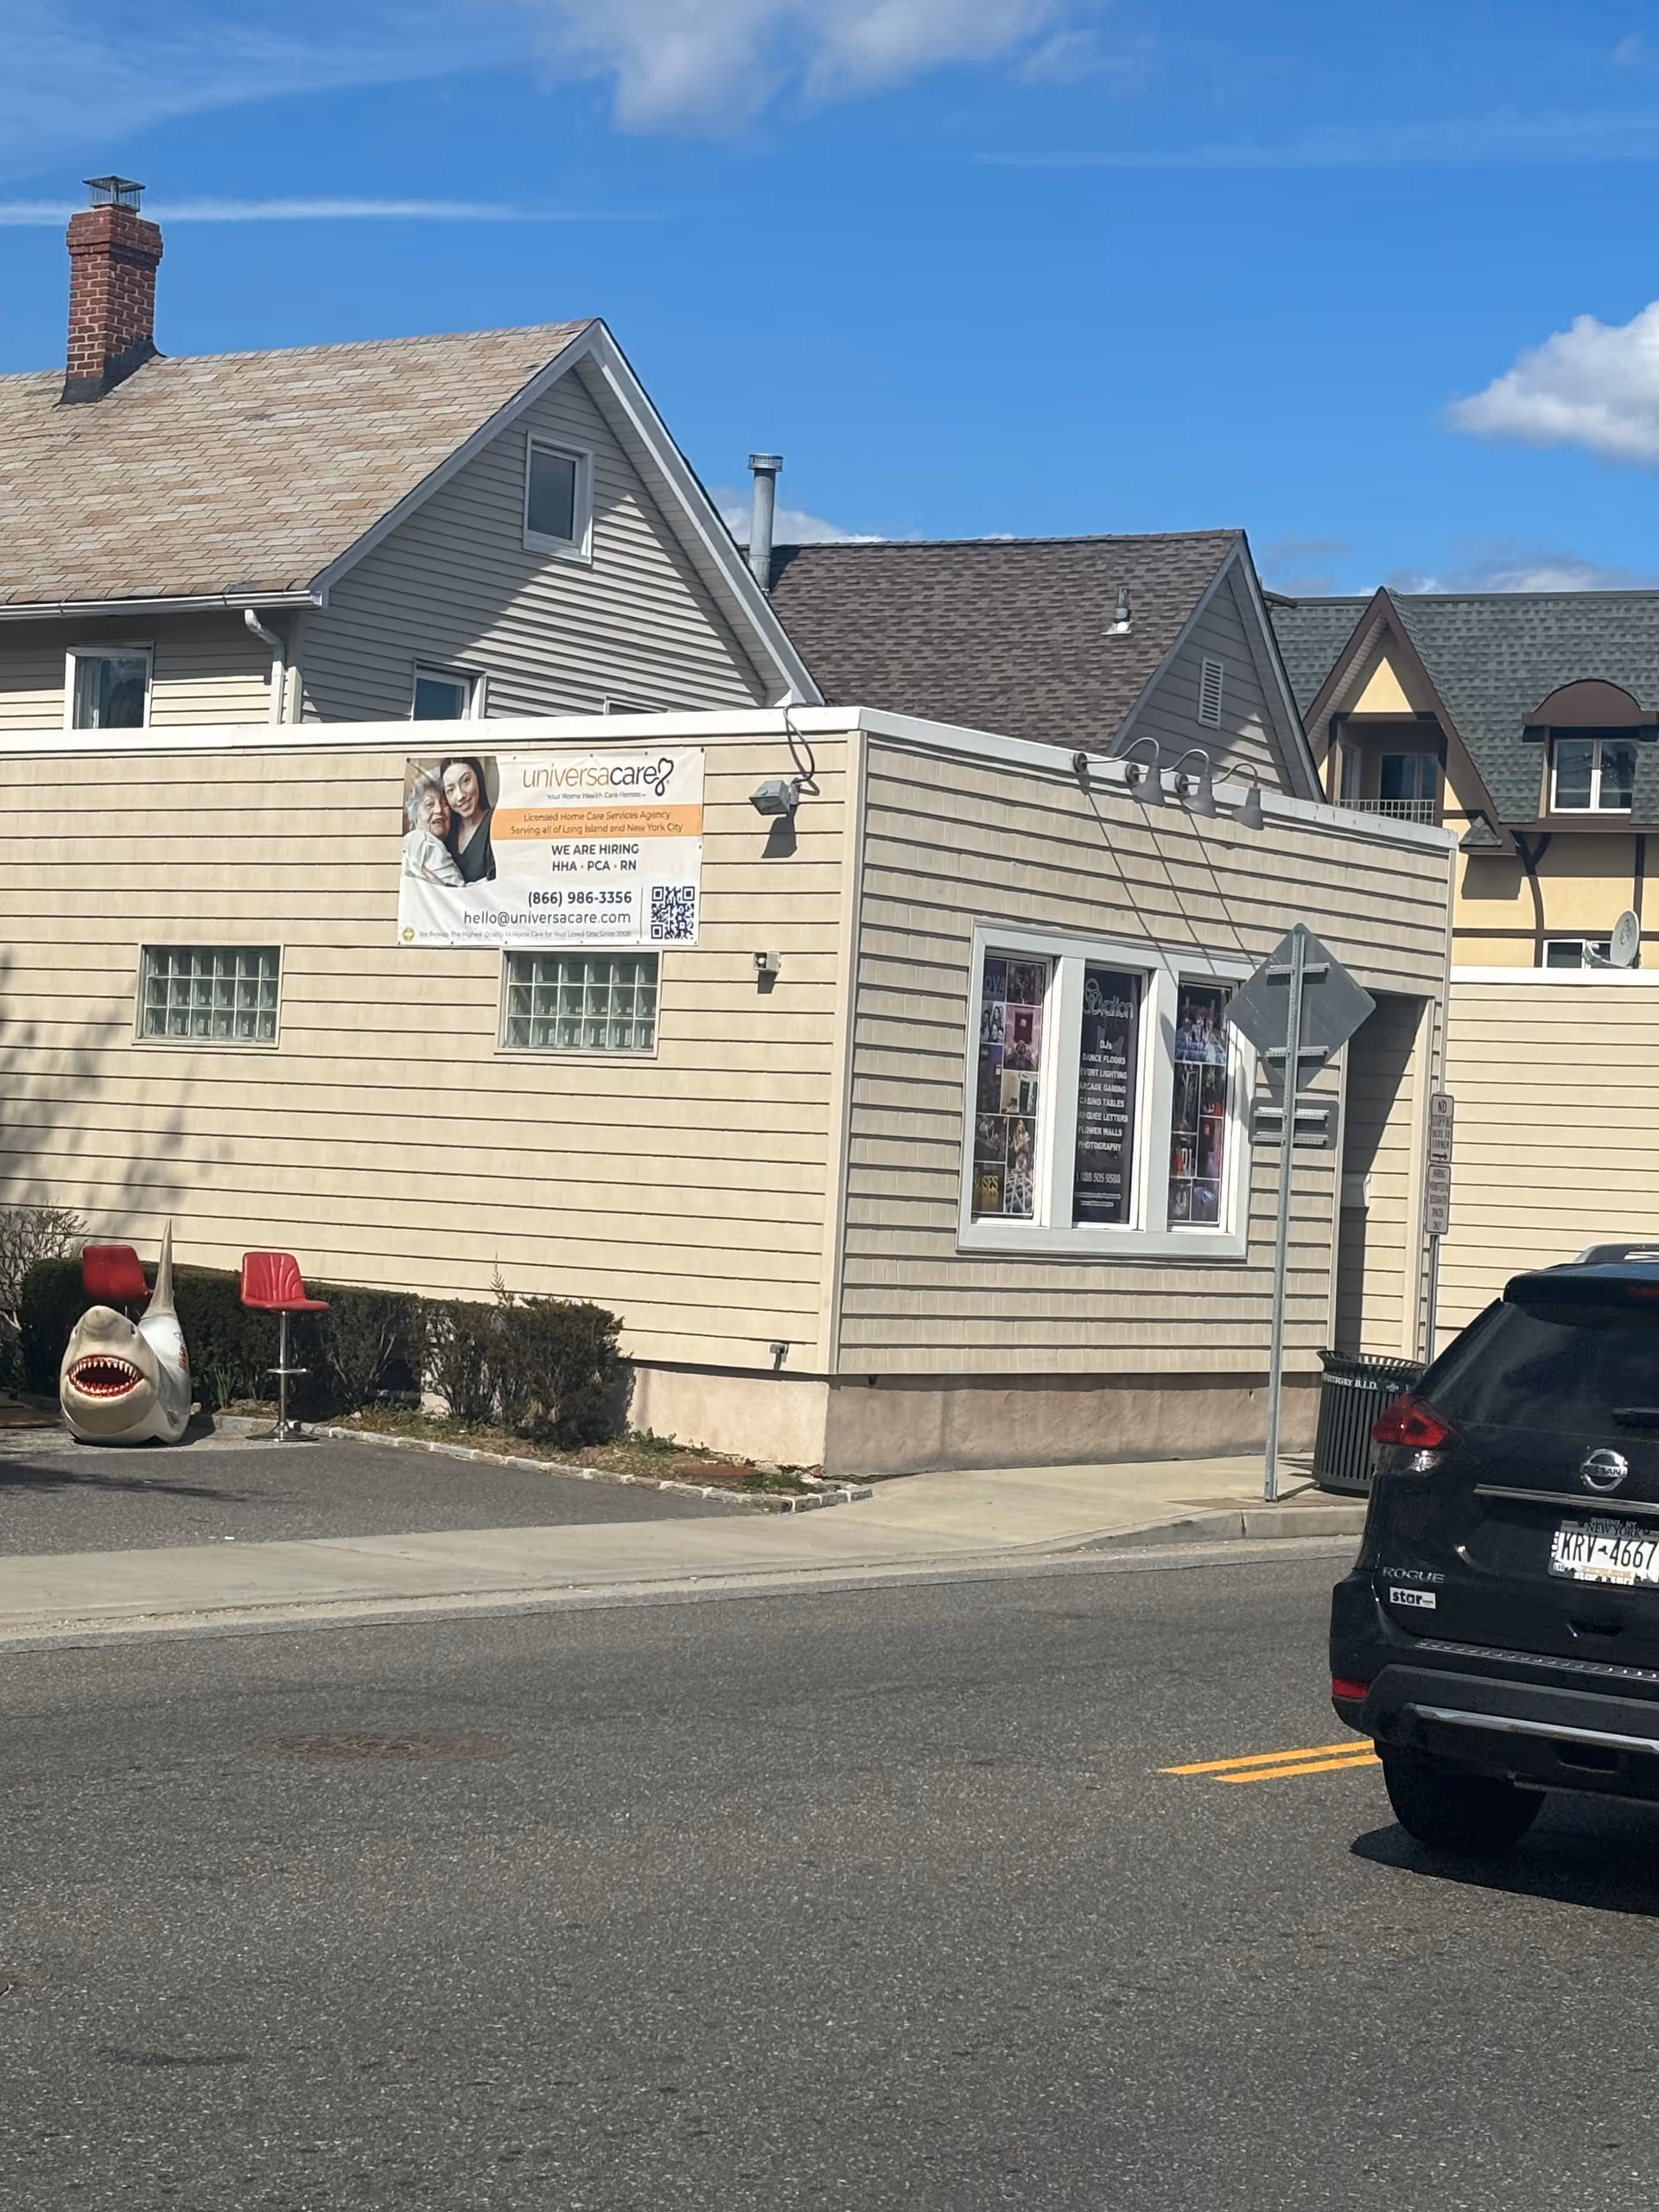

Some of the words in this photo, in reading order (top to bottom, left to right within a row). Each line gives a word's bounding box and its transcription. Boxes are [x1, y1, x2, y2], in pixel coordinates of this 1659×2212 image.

[523, 763, 658, 788] universacare
[524, 811, 559, 823] Licensed
[562, 811, 585, 821] Home
[586, 810, 605, 821] Care
[607, 810, 639, 820] Services
[640, 810, 671, 821] Agency
[511, 825, 541, 836] Serving
[542, 824, 552, 835] all
[553, 824, 562, 834] of
[563, 823, 582, 836] Long
[584, 823, 608, 834] Island
[609, 823, 626, 833] and
[627, 823, 646, 832] New
[647, 823, 665, 831] York
[667, 822, 683, 833] City
[551, 845, 570, 855] WE
[573, 844, 596, 855] ARE
[599, 843, 639, 855] HIRING
[552, 861, 577, 871] HHA
[588, 861, 611, 871] PCA
[620, 860, 637, 871] RN
[528, 891, 563, 907] (866)
[568, 891, 632, 904] 986-3356
[463, 911, 632, 926] hello@universacare.com
[1099, 1039, 1112, 1050] DJs
[1082, 1052, 1102, 1063] DANCE
[1103, 1054, 1126, 1065] FLOORS
[1100, 1069, 1128, 1079] LIGHTING
[1103, 1084, 1127, 1094] GAMING
[1079, 1096, 1102, 1106] CASINO
[1103, 1098, 1125, 1109] TABLES
[1438, 1100, 1447, 1114] NO
[1103, 1113, 1128, 1122] LETTERS
[1078, 1125, 1102, 1135] FLOWER
[1103, 1128, 1122, 1137] WALLS
[1078, 1141, 1122, 1152] PHOTOGRAPHY
[1383, 1567, 1445, 1584] ROGUE
[1392, 1590, 1423, 1605] star
